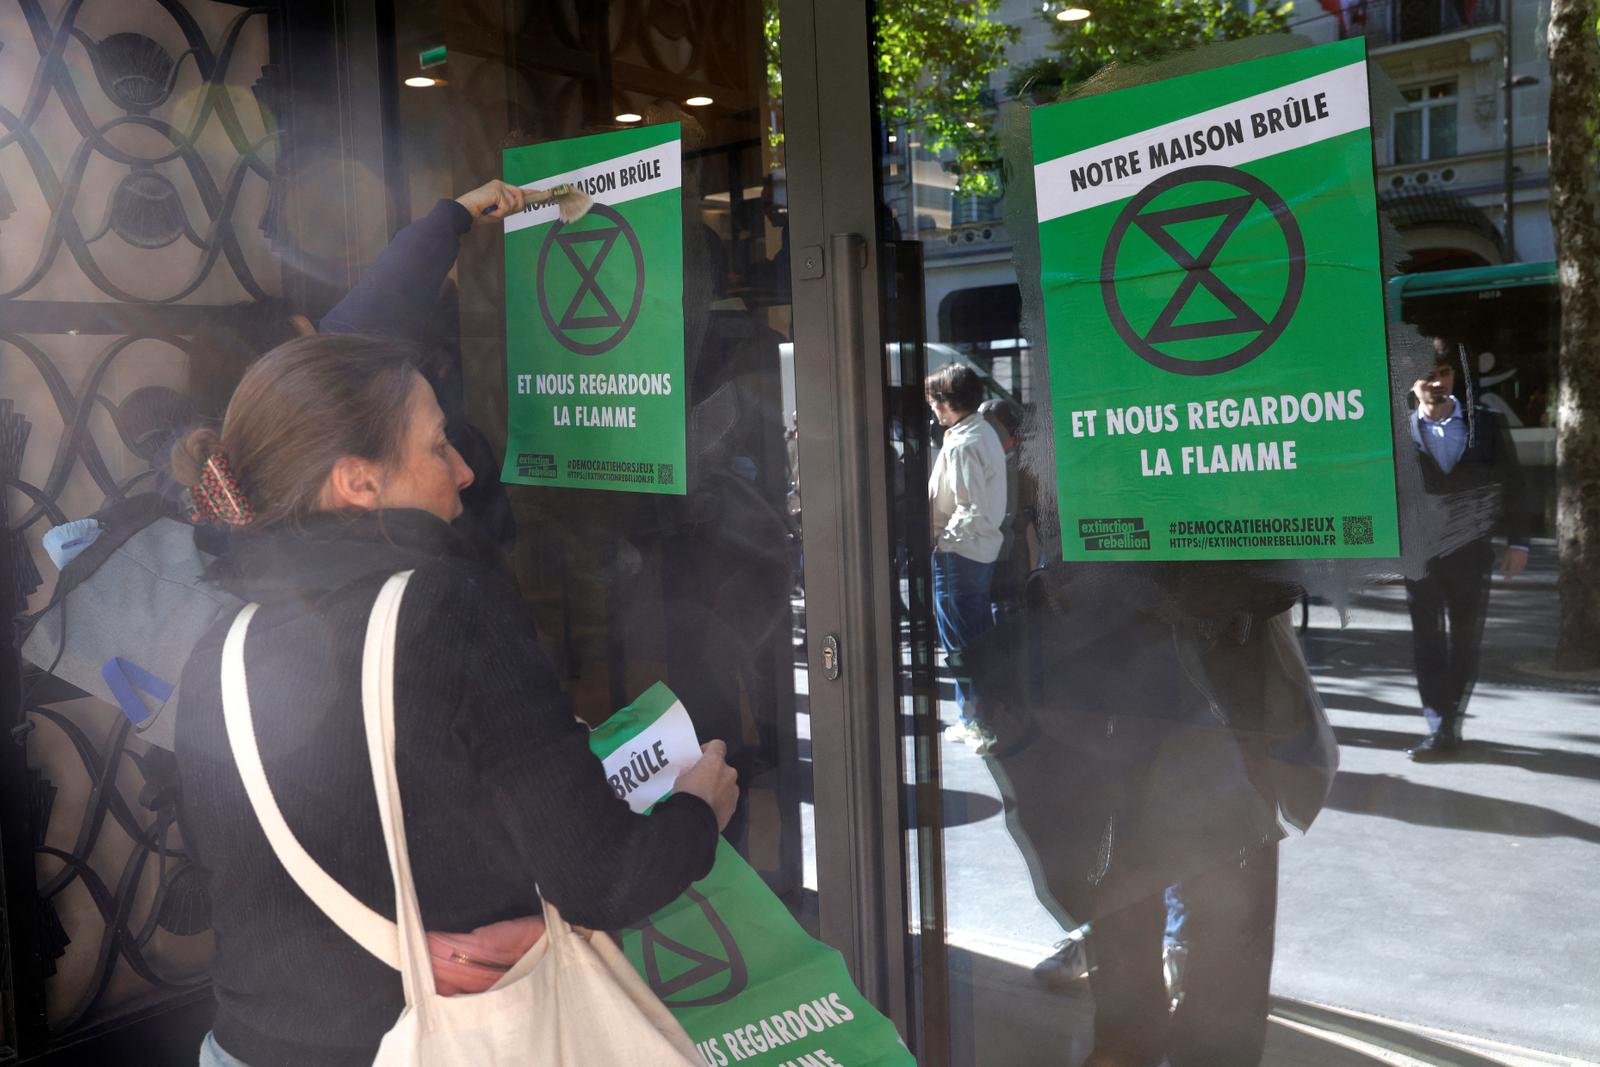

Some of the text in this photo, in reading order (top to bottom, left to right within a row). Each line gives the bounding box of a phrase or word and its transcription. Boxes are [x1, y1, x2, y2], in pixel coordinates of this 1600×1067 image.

[1069, 91, 1330, 192] NOTRE MAISON BRÛLE
[571, 158, 662, 197] AISON BRÛLE
[517, 372, 672, 396] ET NOUS REGARDONS
[553, 405, 636, 428] LA FLAMME
[1071, 388, 1365, 438] ET NOUS REGARDONS
[567, 459, 655, 474] #DEMOCRATIEHORSJEUX
[1140, 440, 1298, 477] LA FLAMME
[1081, 519, 1135, 533] extinction
[1169, 516, 1336, 535] #DEMOCRATIEHORSJEUX
[1098, 532, 1149, 549] rebellion
[1169, 534, 1336, 549] HTTPS://EXTINCTIONREBELLION.FR
[608, 739, 670, 800] BRÛLE
[695, 992, 855, 1067] US REGARDONS
